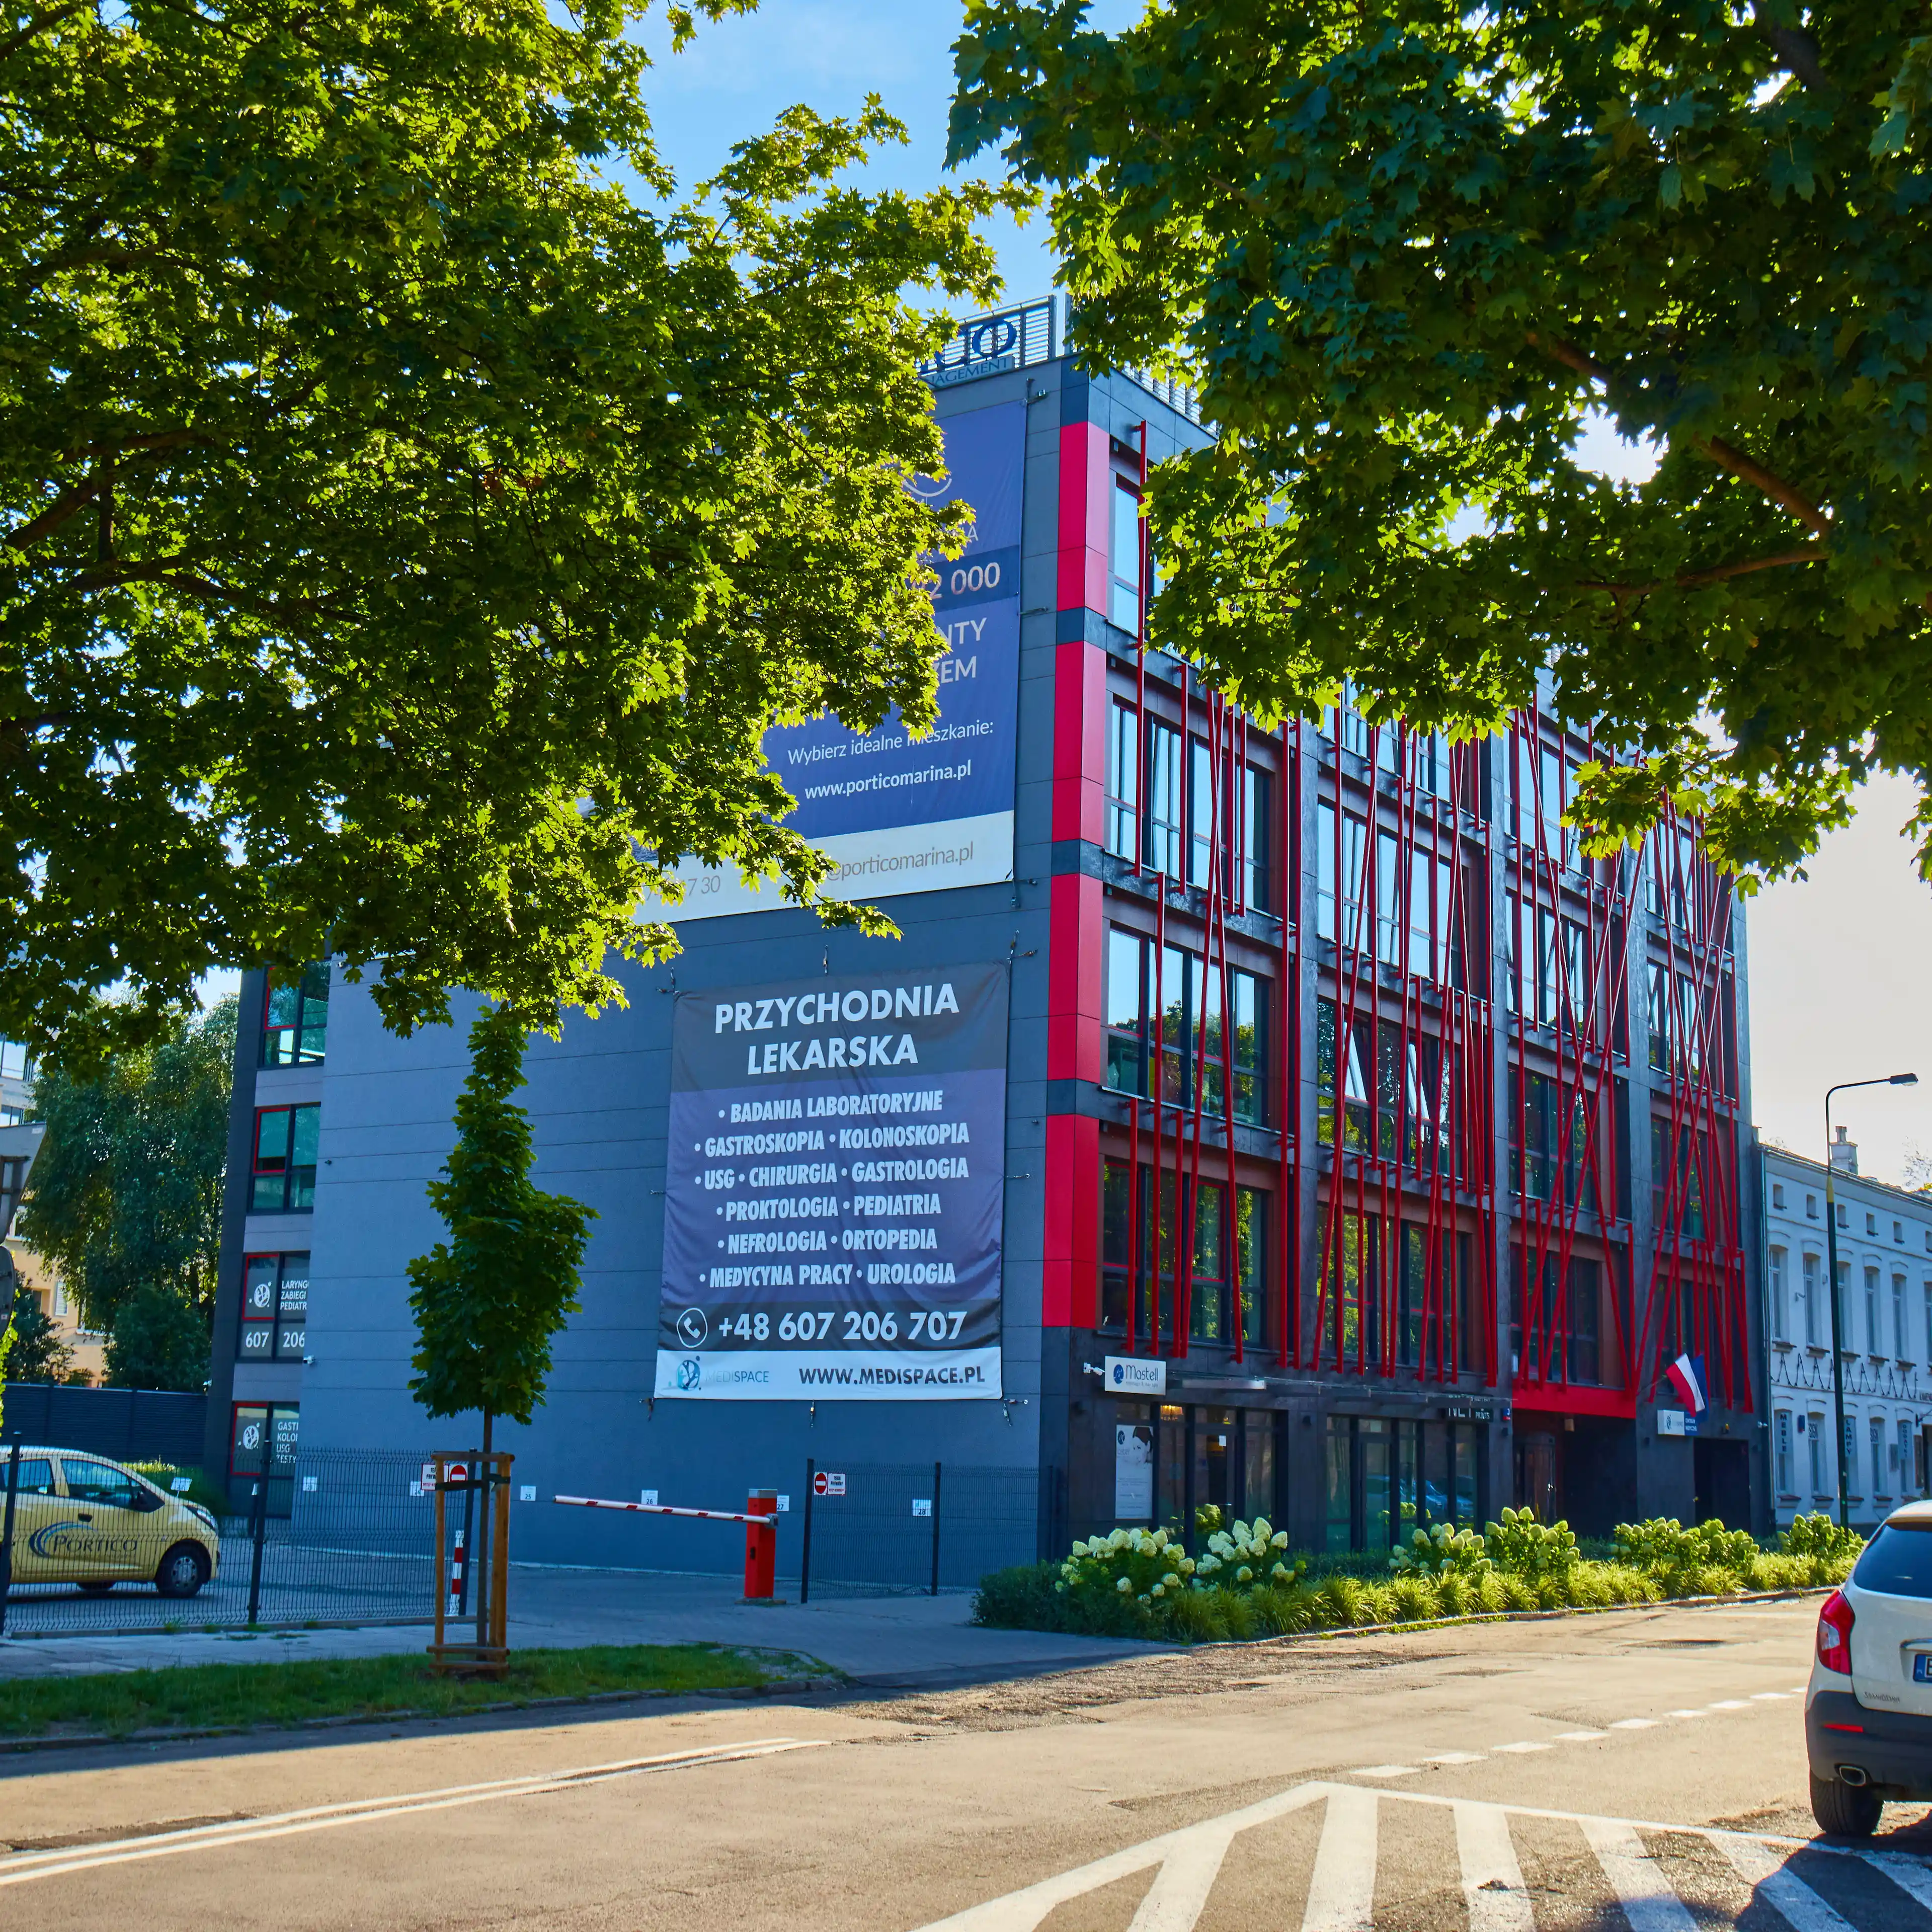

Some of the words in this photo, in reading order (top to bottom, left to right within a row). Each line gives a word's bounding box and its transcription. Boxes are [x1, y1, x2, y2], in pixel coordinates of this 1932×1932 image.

[932, 357, 1008, 385] AGEMENT
[951, 562, 1000, 595] 000
[936, 617, 987, 647] NTY
[788, 743, 846, 765] Wybierz
[850, 735, 903, 756] idealne
[805, 759, 972, 799] www.porticomarina.pl
[828, 842, 974, 881] @porticomarina.pl
[701, 875, 721, 895] 30
[715, 983, 959, 1033] PRZYCHODNIA
[747, 1033, 918, 1075] LEKARSKA
[731, 1099, 802, 1123] BADANIA
[807, 1090, 943, 1117] LABORATORYJNE
[705, 1130, 825, 1157] GASTROSKOPIA
[839, 1122, 970, 1149] KOLONOSKOPIA
[704, 1169, 735, 1190] USG
[749, 1163, 837, 1187] CHIRURGIA
[852, 1157, 969, 1182] GASTROLOGIA
[726, 1195, 839, 1222] PROKTOLOGIA
[854, 1193, 941, 1216] PEDIATRIA
[728, 1231, 827, 1254] NEFROLOGIA
[842, 1229, 938, 1250] ORTOPEDIA
[282, 1280, 308, 1290] LARYNG
[709, 1264, 793, 1288] MEDYCYNA
[799, 1264, 852, 1286] PRACY
[867, 1262, 956, 1284] UROLOGIA
[281, 1292, 306, 1300] ZABIEGI
[246, 1332, 269, 1348] 607
[283, 1332, 305, 1347] 206
[718, 1312, 769, 1341] +48
[778, 1312, 835, 1340] 607
[843, 1311, 898, 1340] 206
[908, 1311, 968, 1339] 707
[799, 1365, 985, 1386] WWW.MEDISPACE.PL
